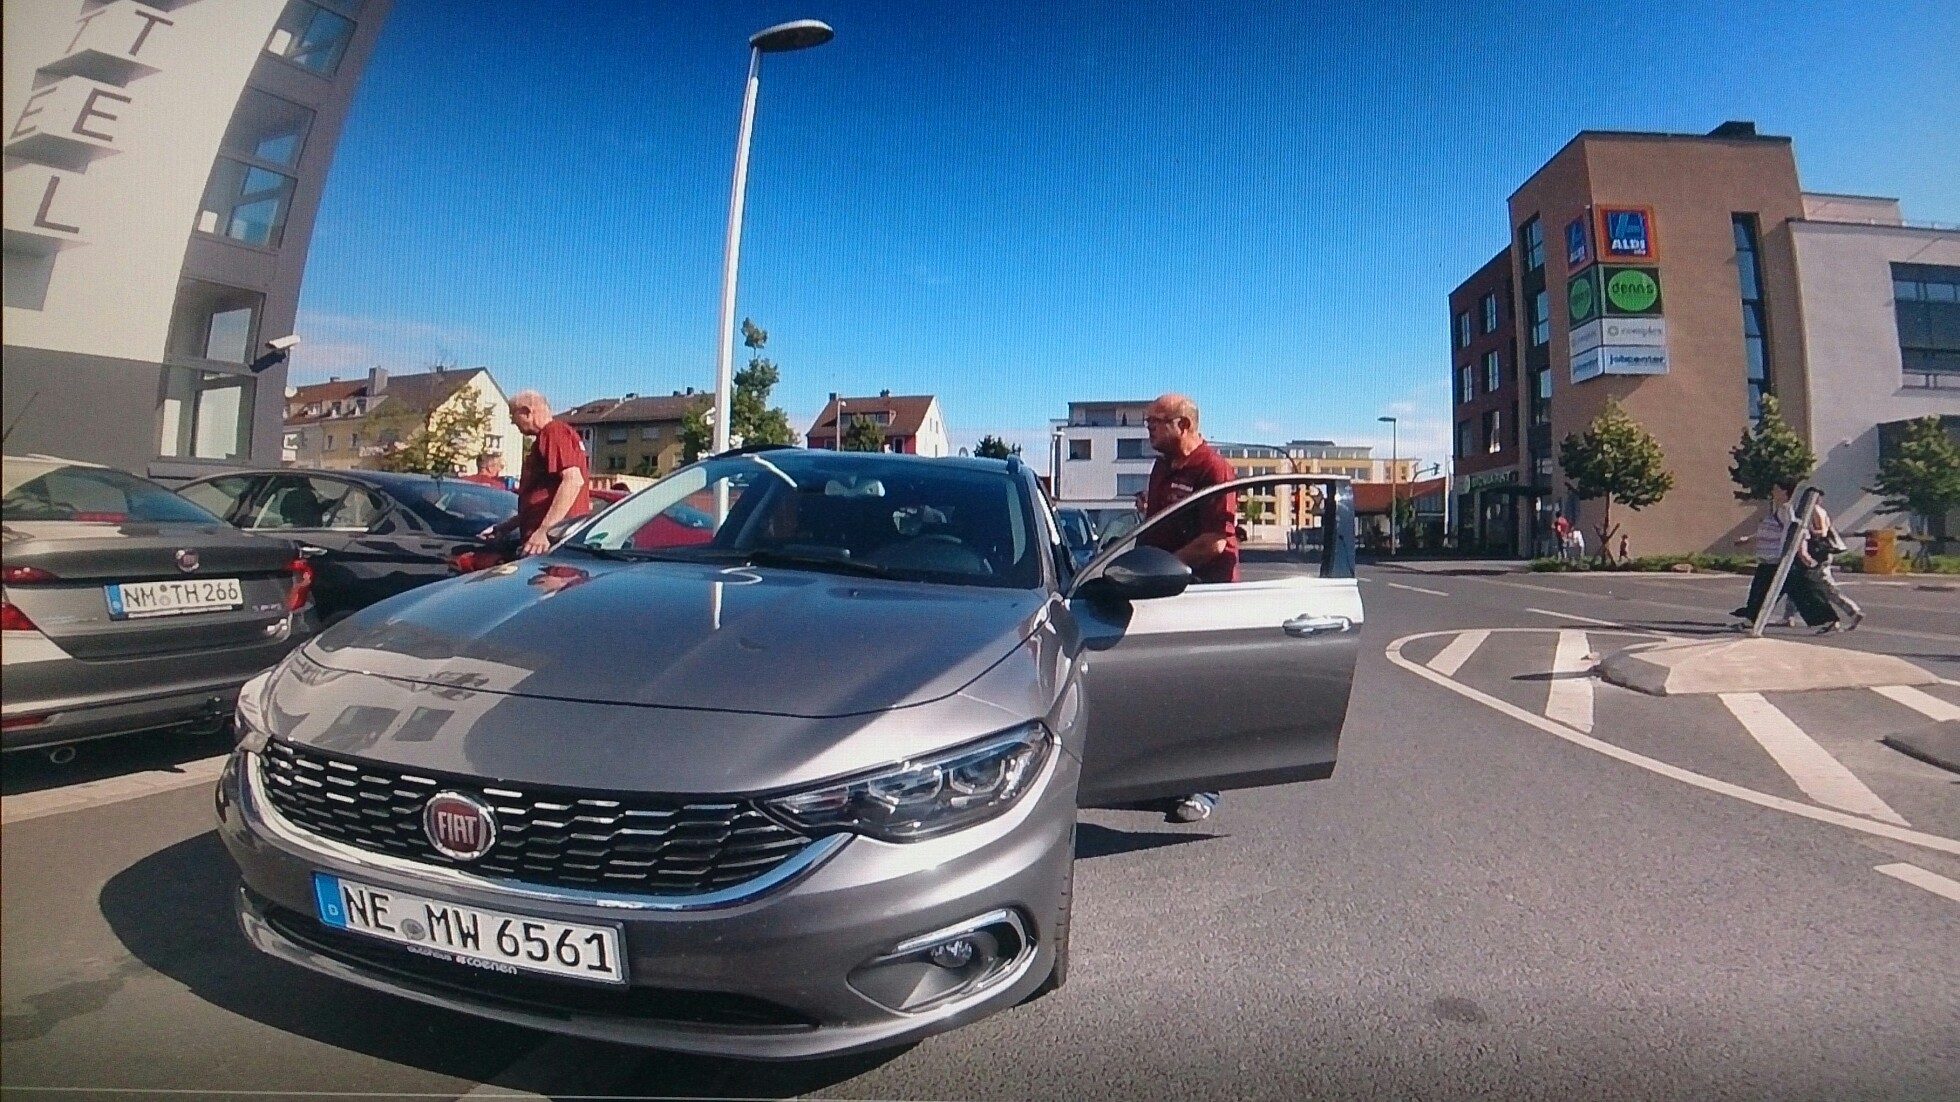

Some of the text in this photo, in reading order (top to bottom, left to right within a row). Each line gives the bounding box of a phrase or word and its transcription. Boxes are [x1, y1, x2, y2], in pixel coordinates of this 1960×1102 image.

[1611, 238, 1646, 250] ALDI
[123, 582, 239, 608] NM TH 266
[436, 810, 478, 845] FIAT
[342, 885, 613, 974] NE MW 6561
